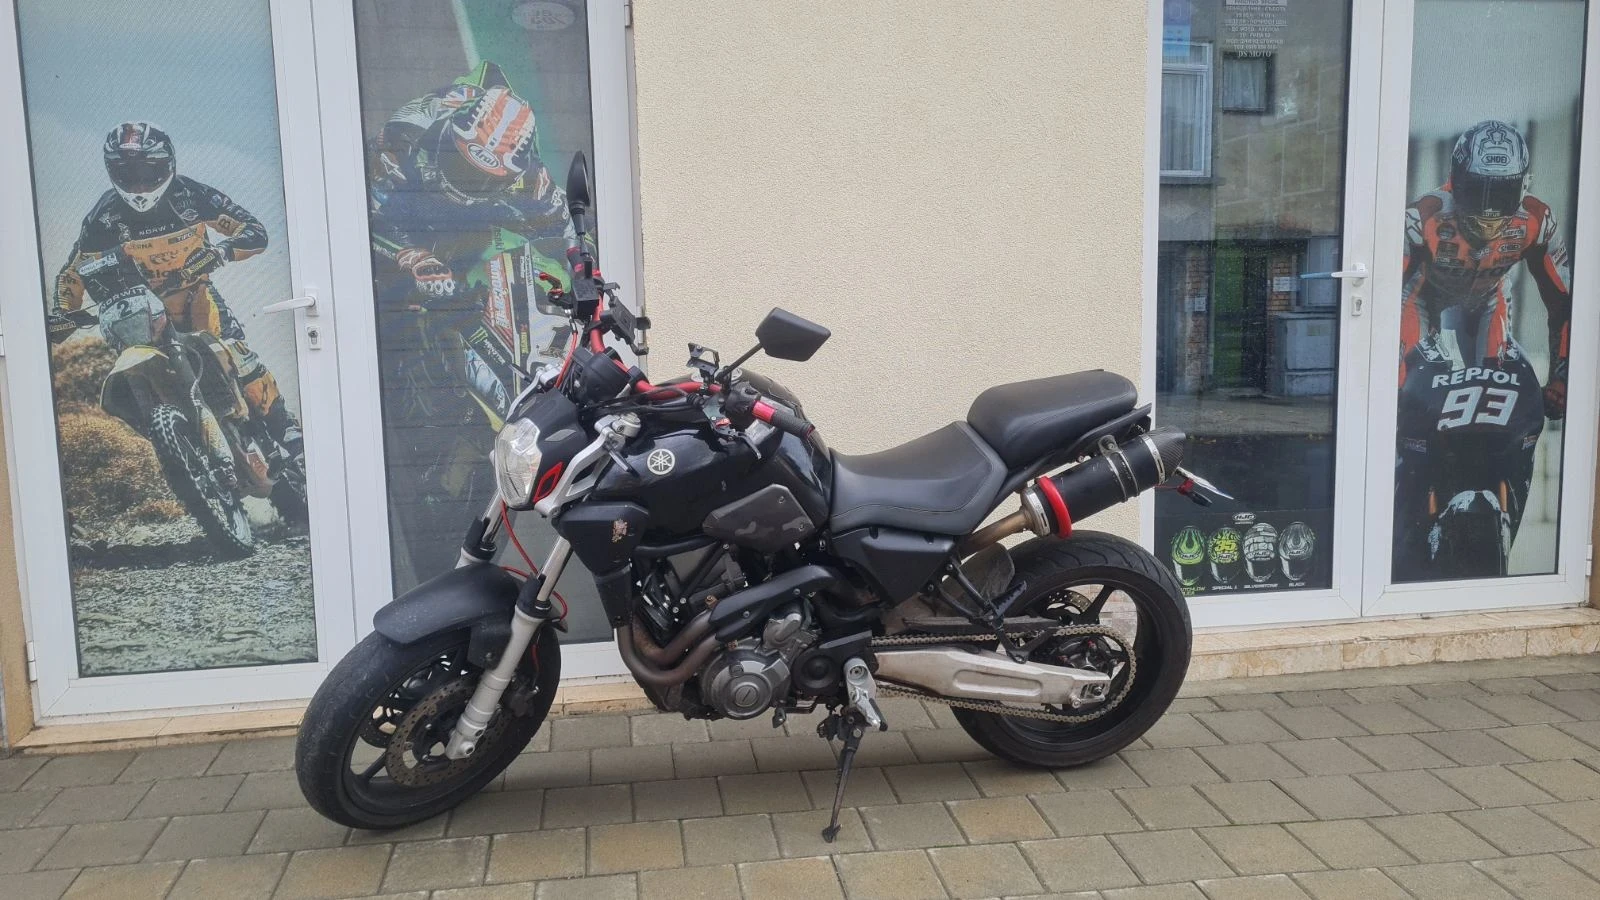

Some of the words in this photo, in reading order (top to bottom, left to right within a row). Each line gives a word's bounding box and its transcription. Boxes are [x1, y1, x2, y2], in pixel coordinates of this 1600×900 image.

[116, 300, 133, 318] 2
[1432, 367, 1520, 389] REPSOL
[1437, 386, 1519, 431] 93
